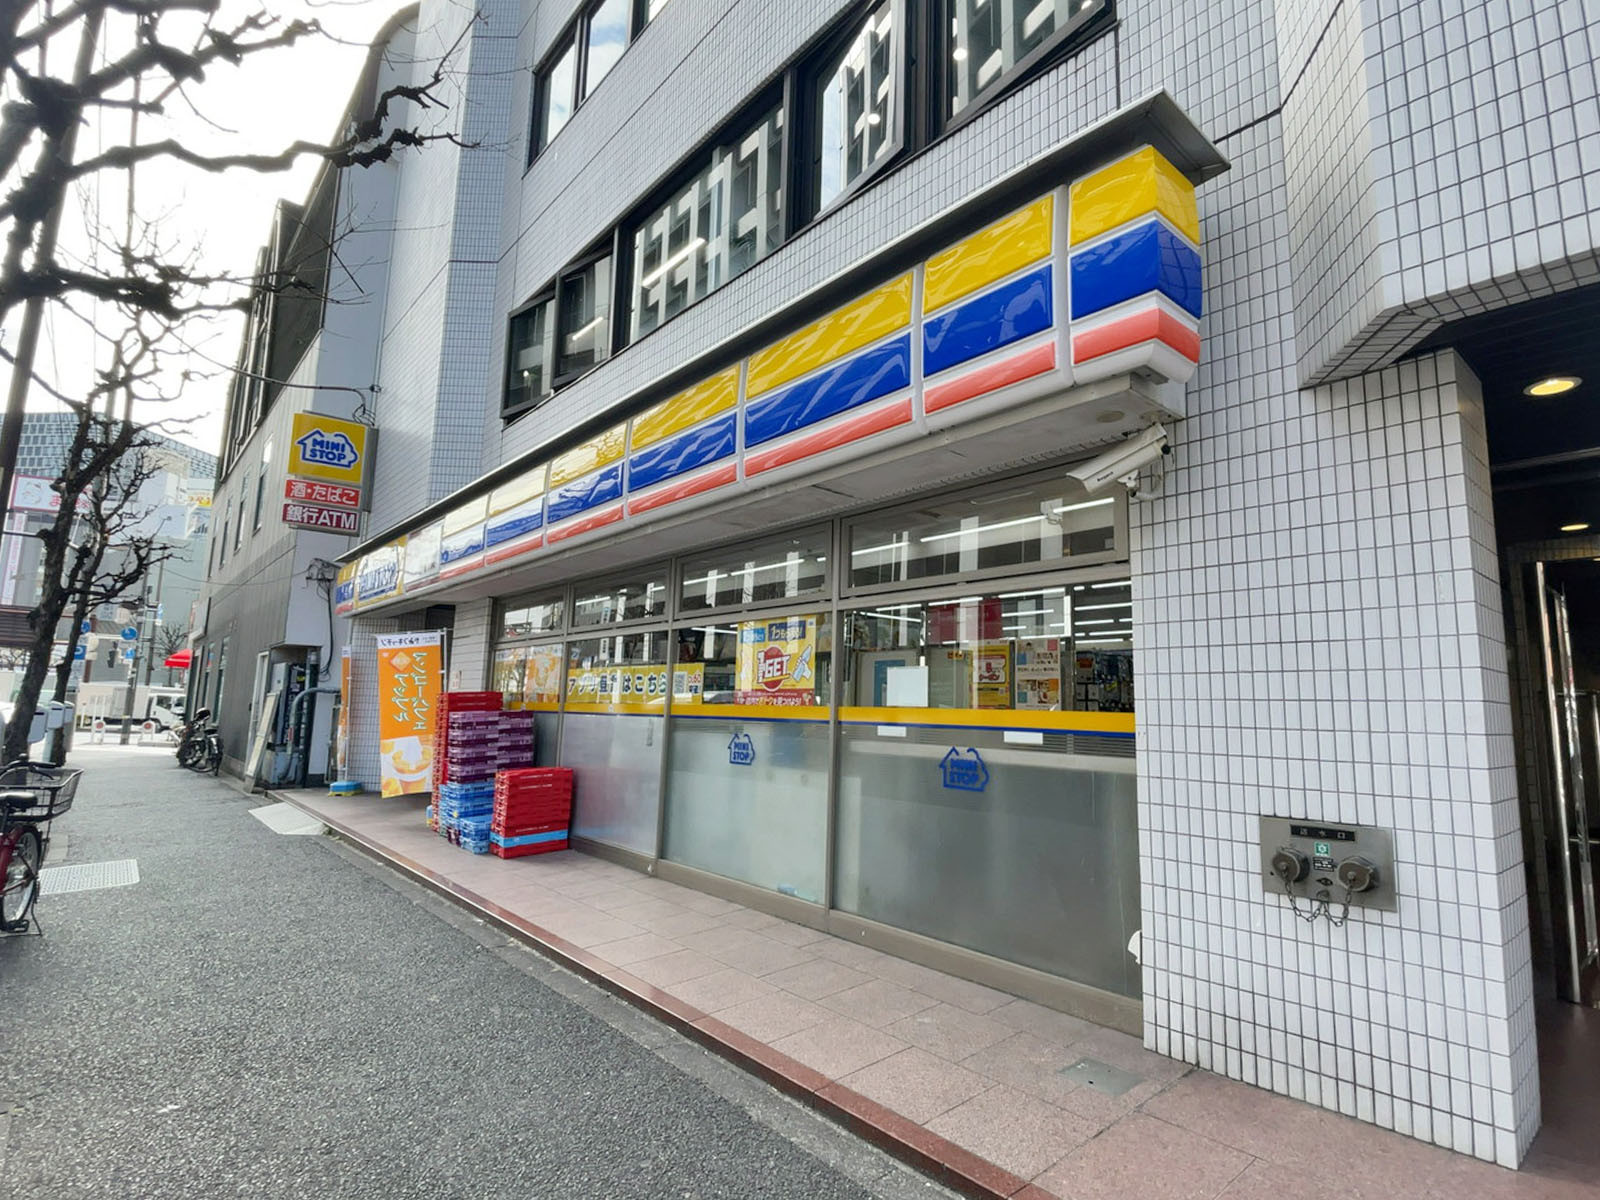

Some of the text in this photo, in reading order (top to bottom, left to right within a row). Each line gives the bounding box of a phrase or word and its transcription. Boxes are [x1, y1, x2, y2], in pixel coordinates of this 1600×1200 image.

[311, 438, 346, 452] MINI
[309, 448, 347, 462] STOP
[290, 481, 356, 505] 酒・たばこ
[286, 505, 355, 529] 銀行ATM
[765, 656, 790, 678] GET
[732, 751, 750, 761] STOP
